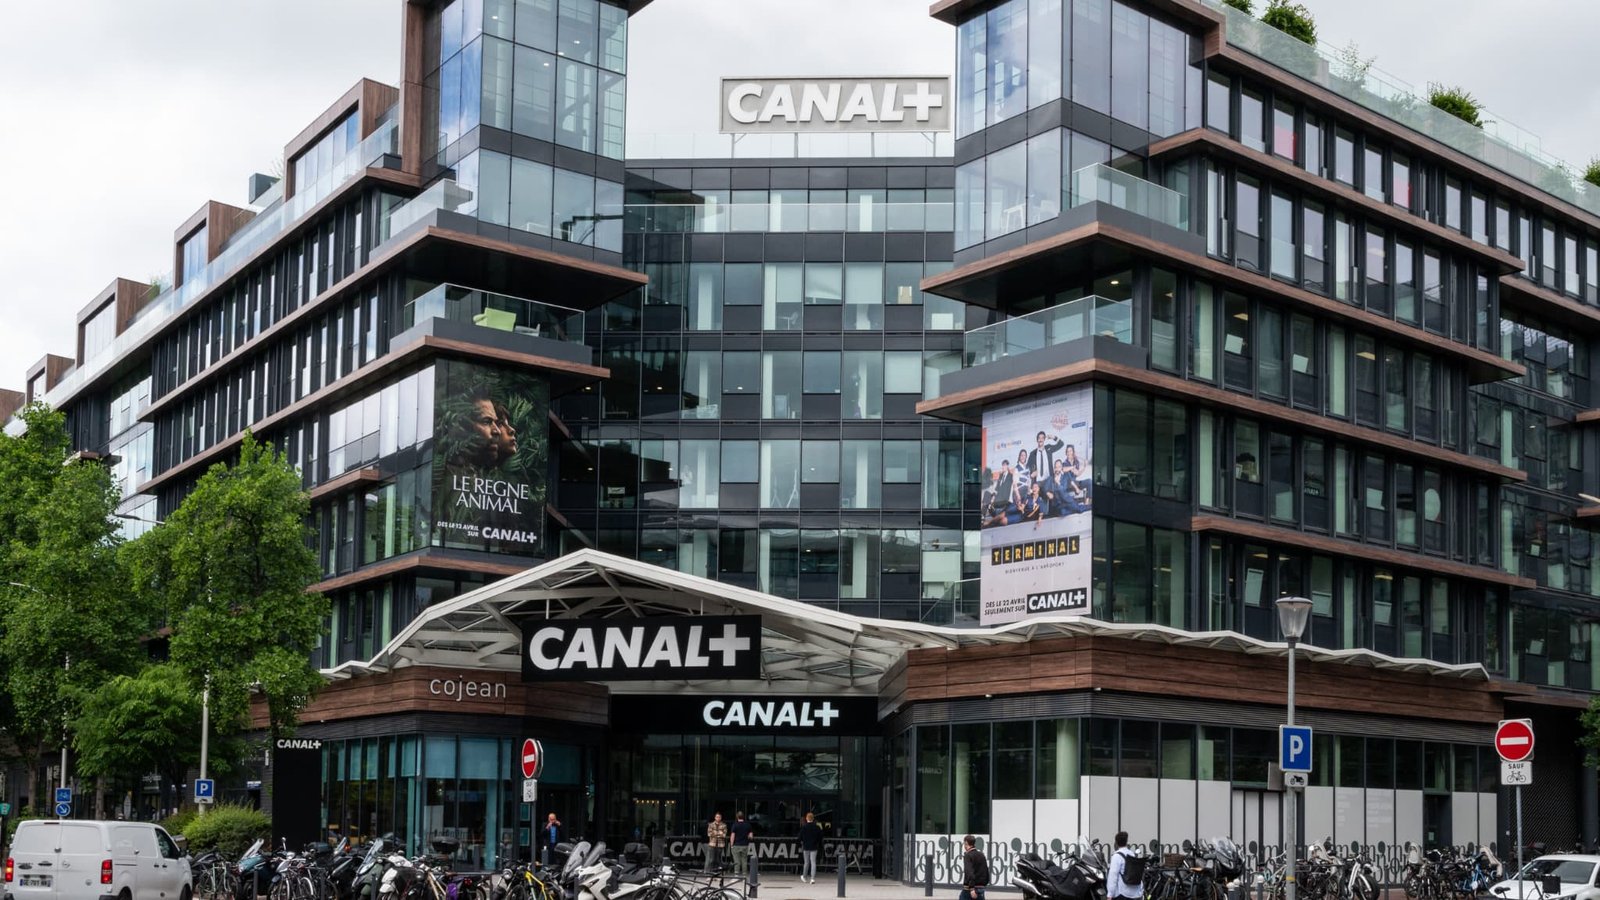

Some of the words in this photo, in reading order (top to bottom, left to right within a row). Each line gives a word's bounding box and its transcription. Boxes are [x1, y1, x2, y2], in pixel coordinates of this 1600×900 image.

[728, 82, 943, 124] CANAL+
[453, 475, 470, 492] LE
[474, 478, 529, 500] REGNE
[456, 492, 522, 515] ANIMAL
[482, 527, 537, 544] CANAL+
[993, 539, 1077, 562] TERMINAL
[984, 607, 1014, 616] SEULEMENT
[1028, 591, 1085, 610] CANAL+
[529, 624, 750, 671] CANAL+
[430, 675, 506, 701] cojean
[703, 701, 839, 727] CANAL+
[277, 738, 321, 750] CANAL+
[1290, 735, 1303, 762] P
[200, 783, 208, 794] P
[746, 842, 803, 859] ANAL
[823, 843, 874, 859] CANA
